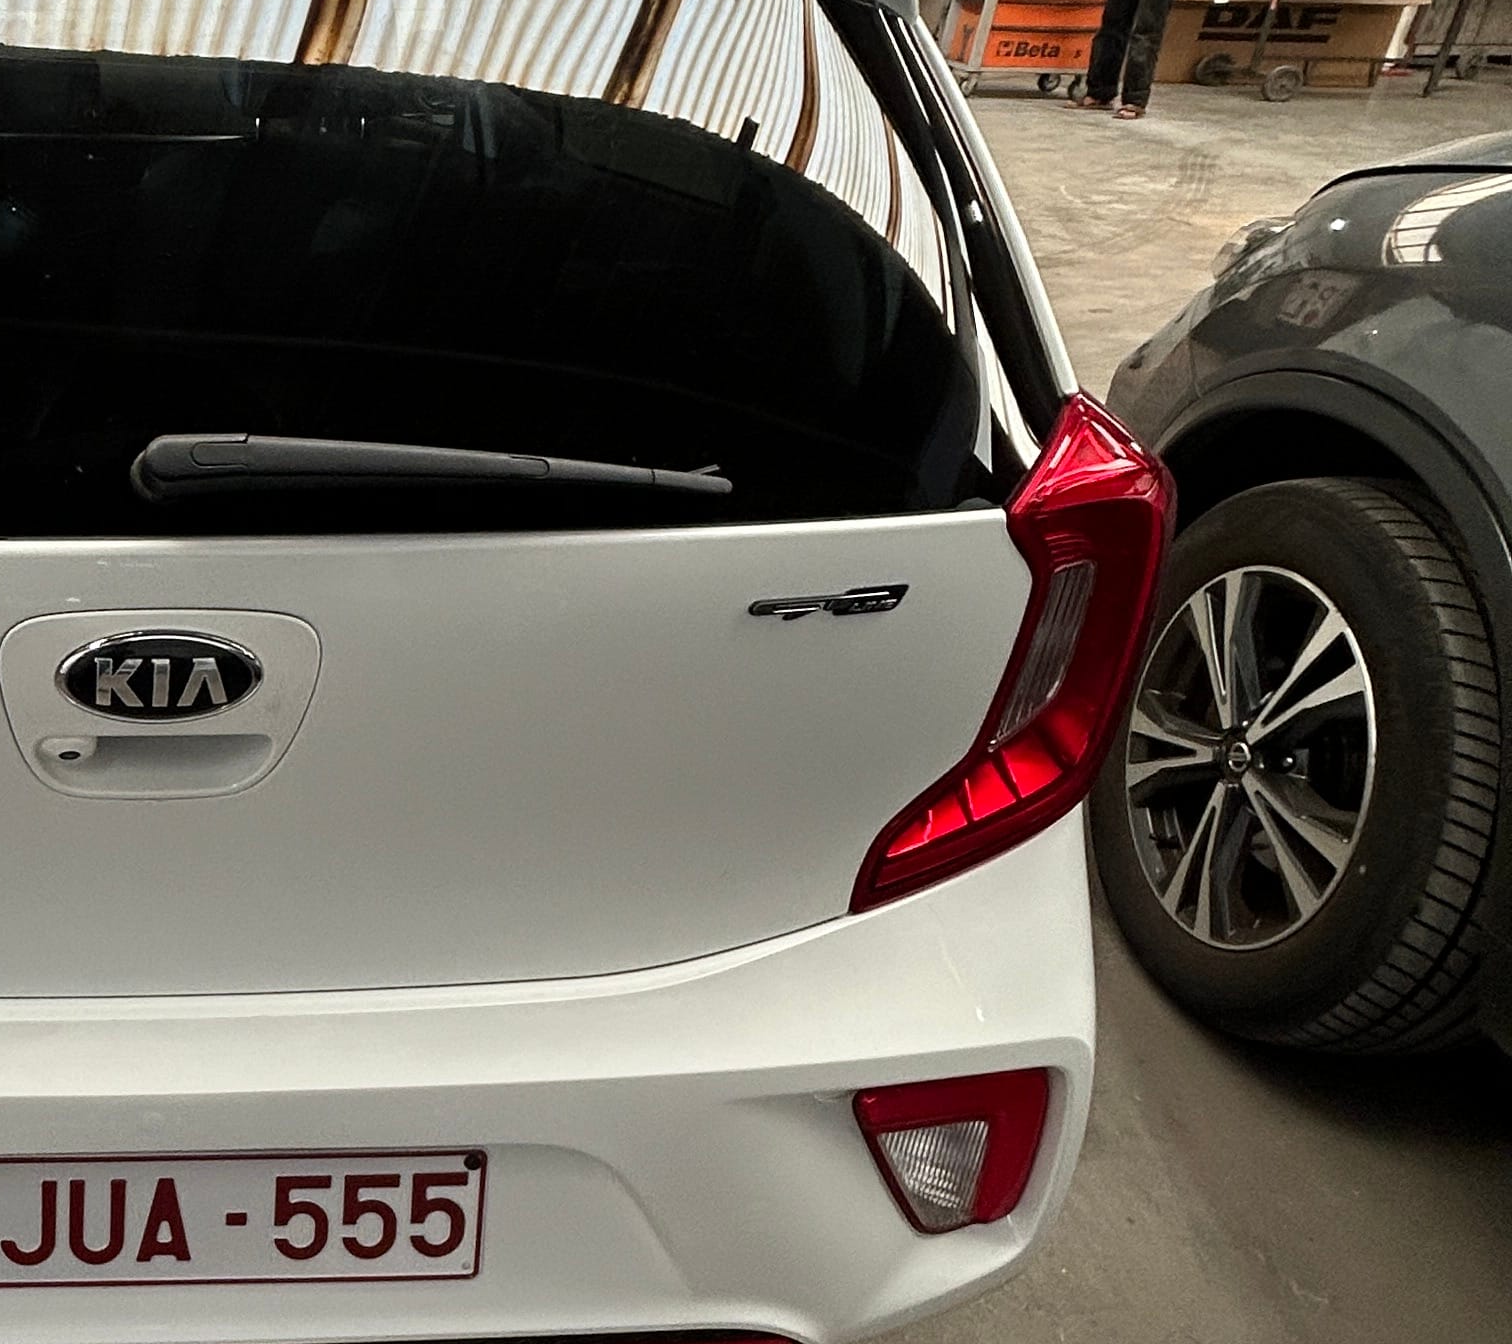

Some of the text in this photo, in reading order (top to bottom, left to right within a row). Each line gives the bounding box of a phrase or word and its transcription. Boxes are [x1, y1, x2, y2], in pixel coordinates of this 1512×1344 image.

[1201, 6, 1343, 30] DAF
[1013, 40, 1061, 58] Beta
[94, 657, 229, 708] KIA
